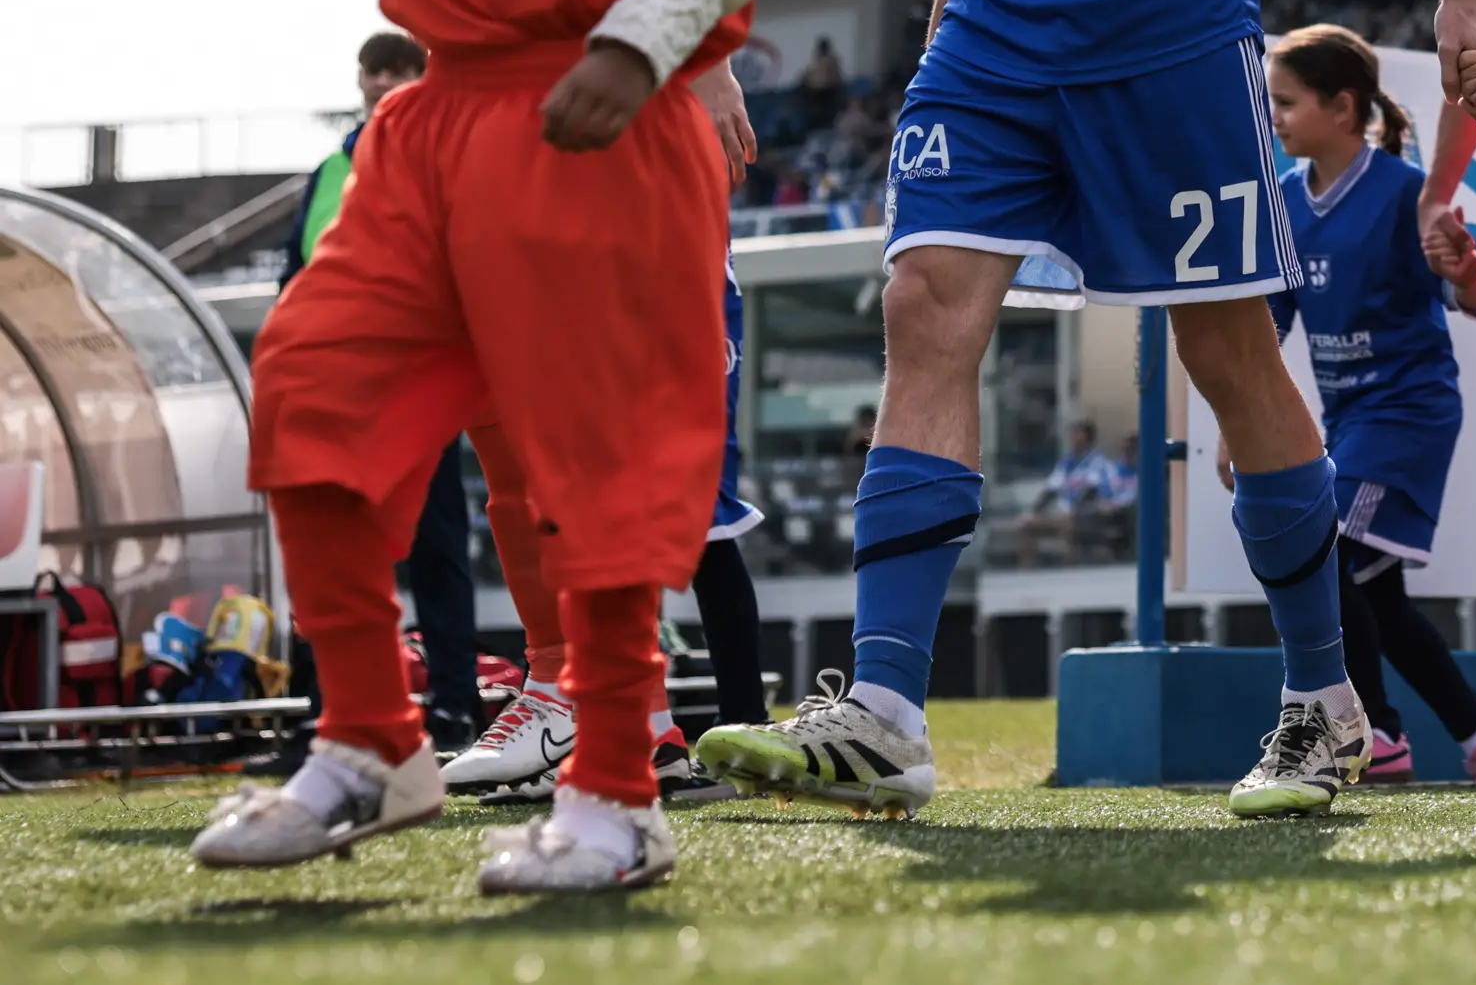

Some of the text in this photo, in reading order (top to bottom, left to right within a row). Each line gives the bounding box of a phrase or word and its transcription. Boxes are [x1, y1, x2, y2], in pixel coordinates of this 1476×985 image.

[902, 167, 949, 181] ADVISOR
[1169, 180, 1259, 283] 27
[1310, 330, 1371, 349] FERALPI
